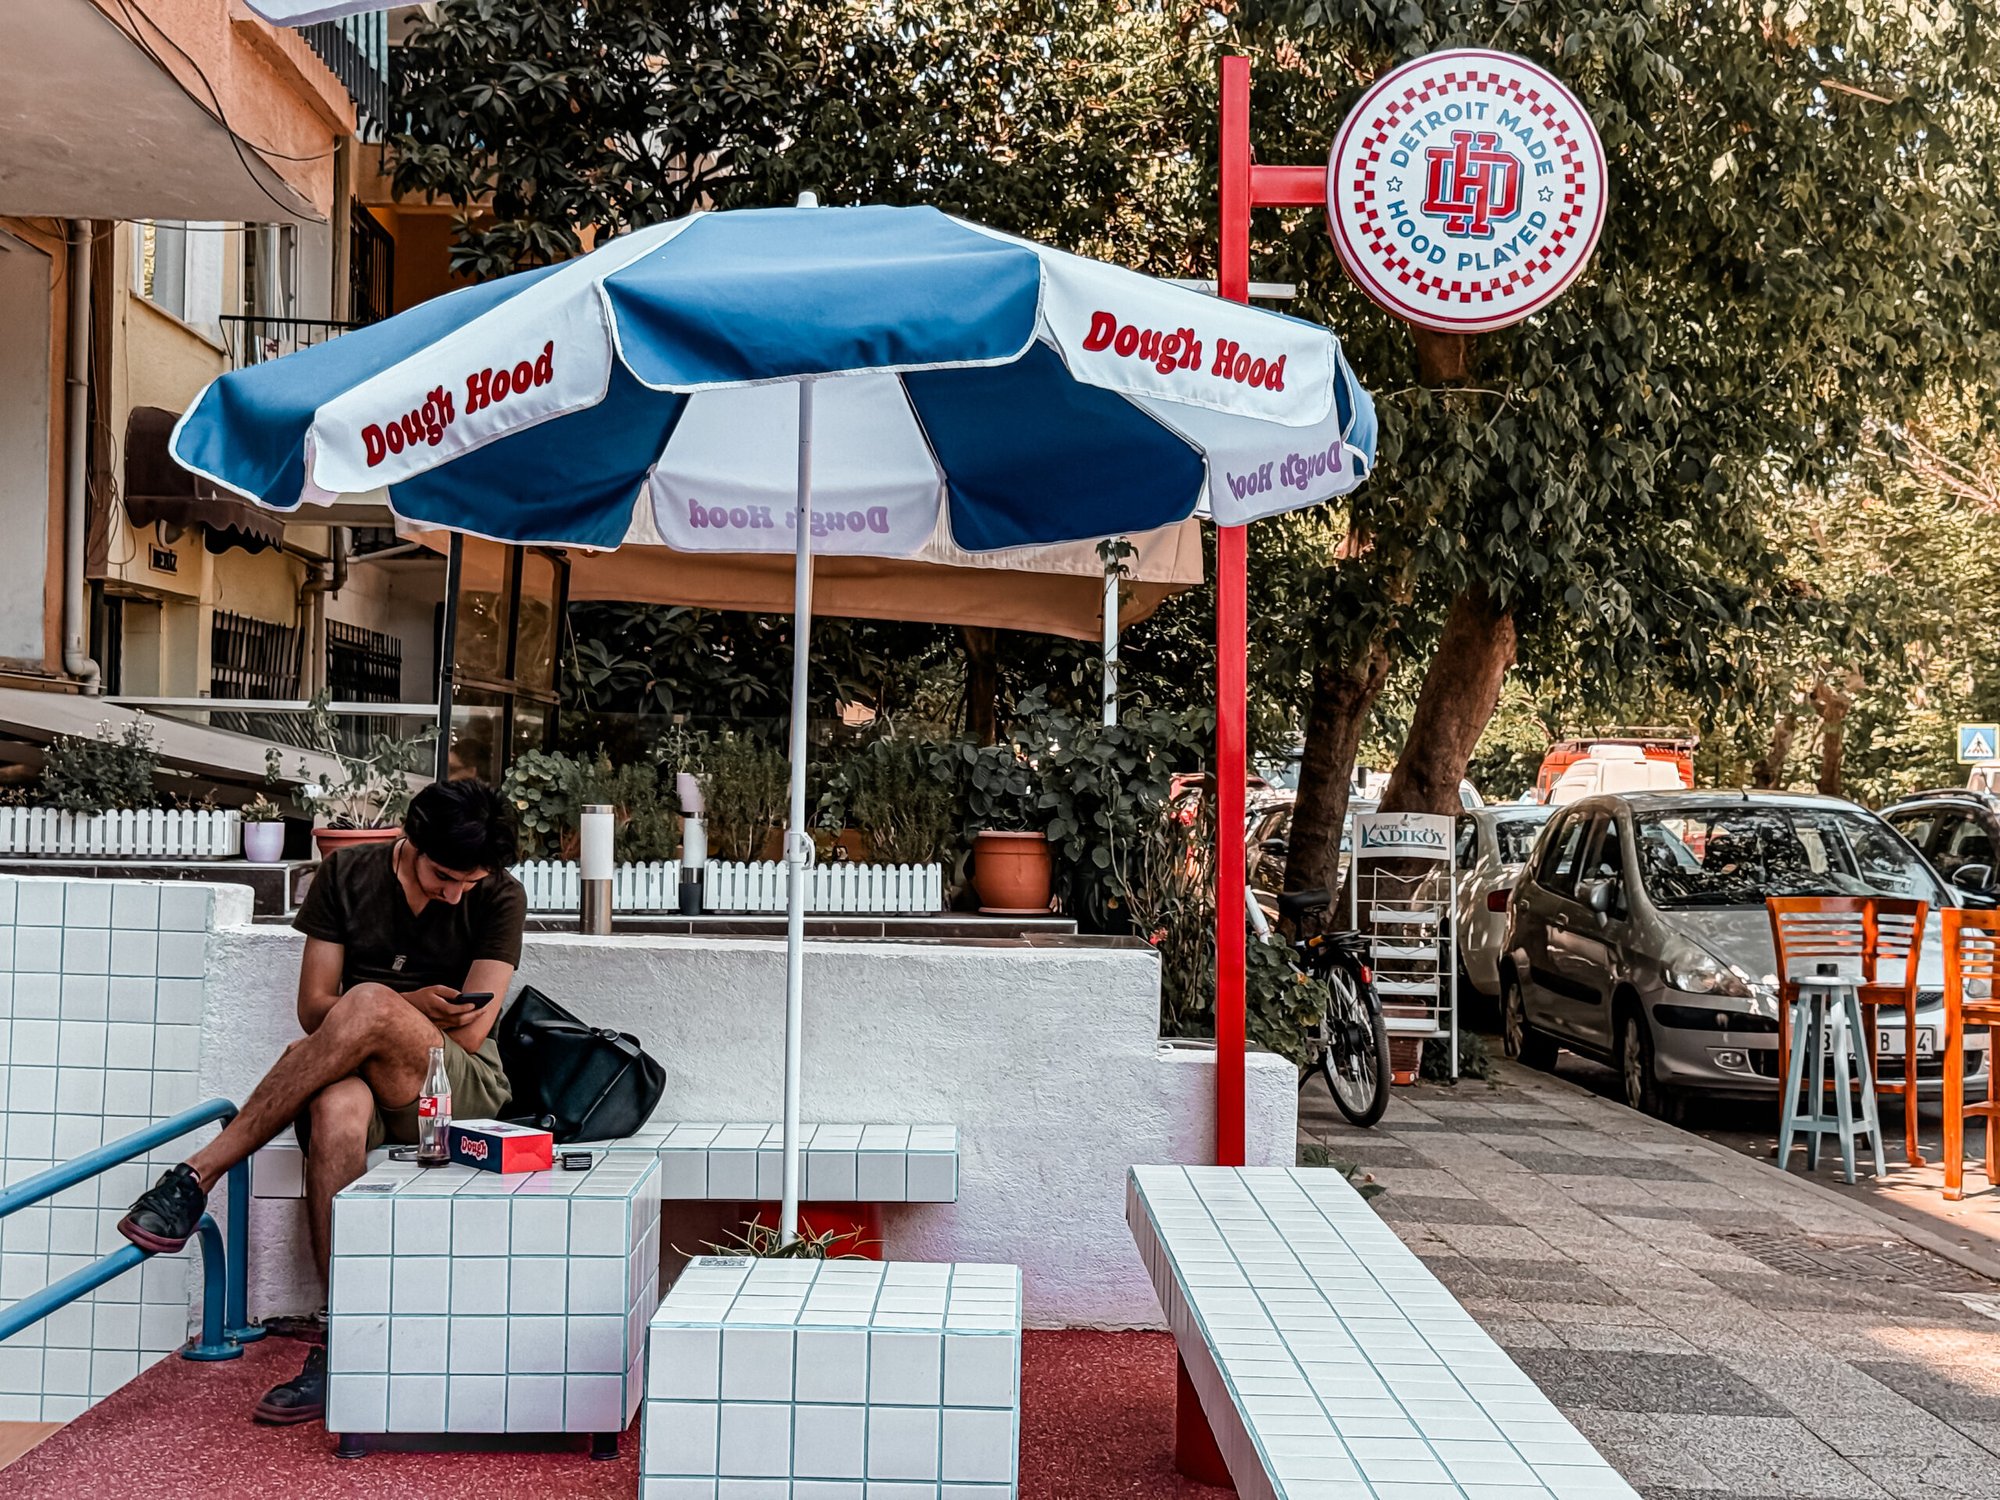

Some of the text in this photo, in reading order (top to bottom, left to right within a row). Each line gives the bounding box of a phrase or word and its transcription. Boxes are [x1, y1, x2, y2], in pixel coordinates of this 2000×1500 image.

[1390, 102, 1554, 176] DETROIT MADE
[1387, 200, 1547, 271] HOOD PLAYED
[1082, 311, 1287, 392] Dough Hood
[361, 340, 554, 467] Dough Hood
[1361, 823, 1446, 848] KADIKÖY
[461, 1136, 488, 1160] Dough
